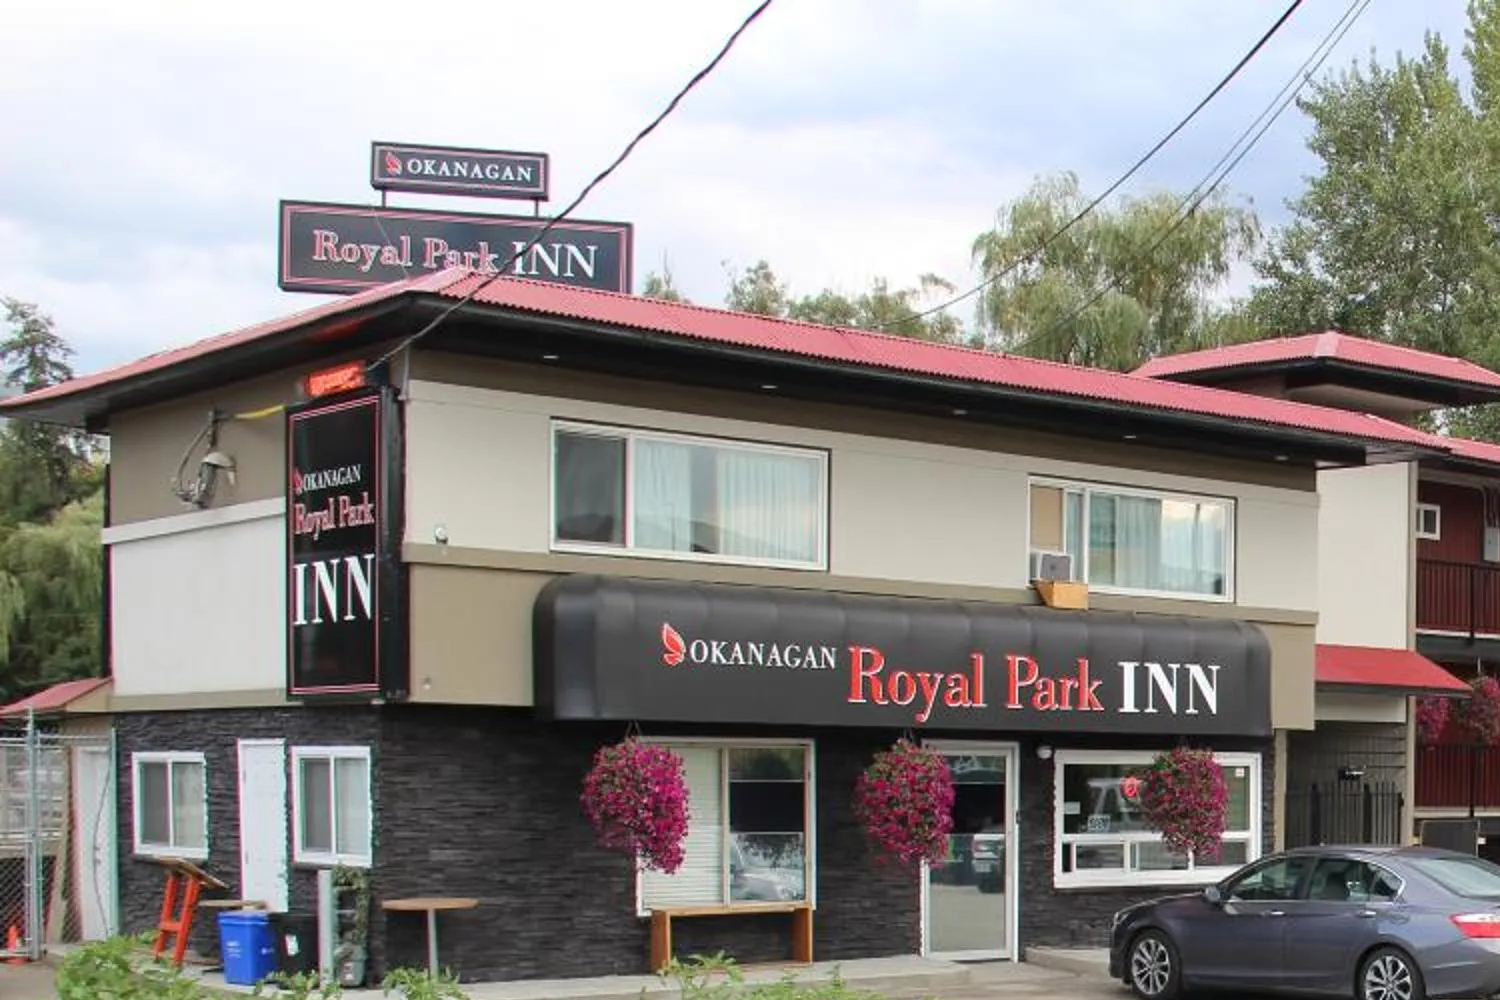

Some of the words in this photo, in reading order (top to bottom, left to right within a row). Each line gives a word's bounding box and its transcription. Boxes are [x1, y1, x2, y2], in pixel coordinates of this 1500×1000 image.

[407, 158, 532, 182] OKANAGAN
[312, 229, 412, 271] Royal
[423, 237, 499, 275] Park
[511, 241, 599, 279] INN
[303, 463, 361, 492] OKANAGAN
[294, 497, 335, 540] Royal
[338, 491, 375, 527] Park
[293, 554, 375, 625] INN
[689, 639, 836, 670] OKANAGAN
[847, 643, 988, 724] Royal
[1005, 655, 1105, 712] Park
[1118, 661, 1221, 715] INN
